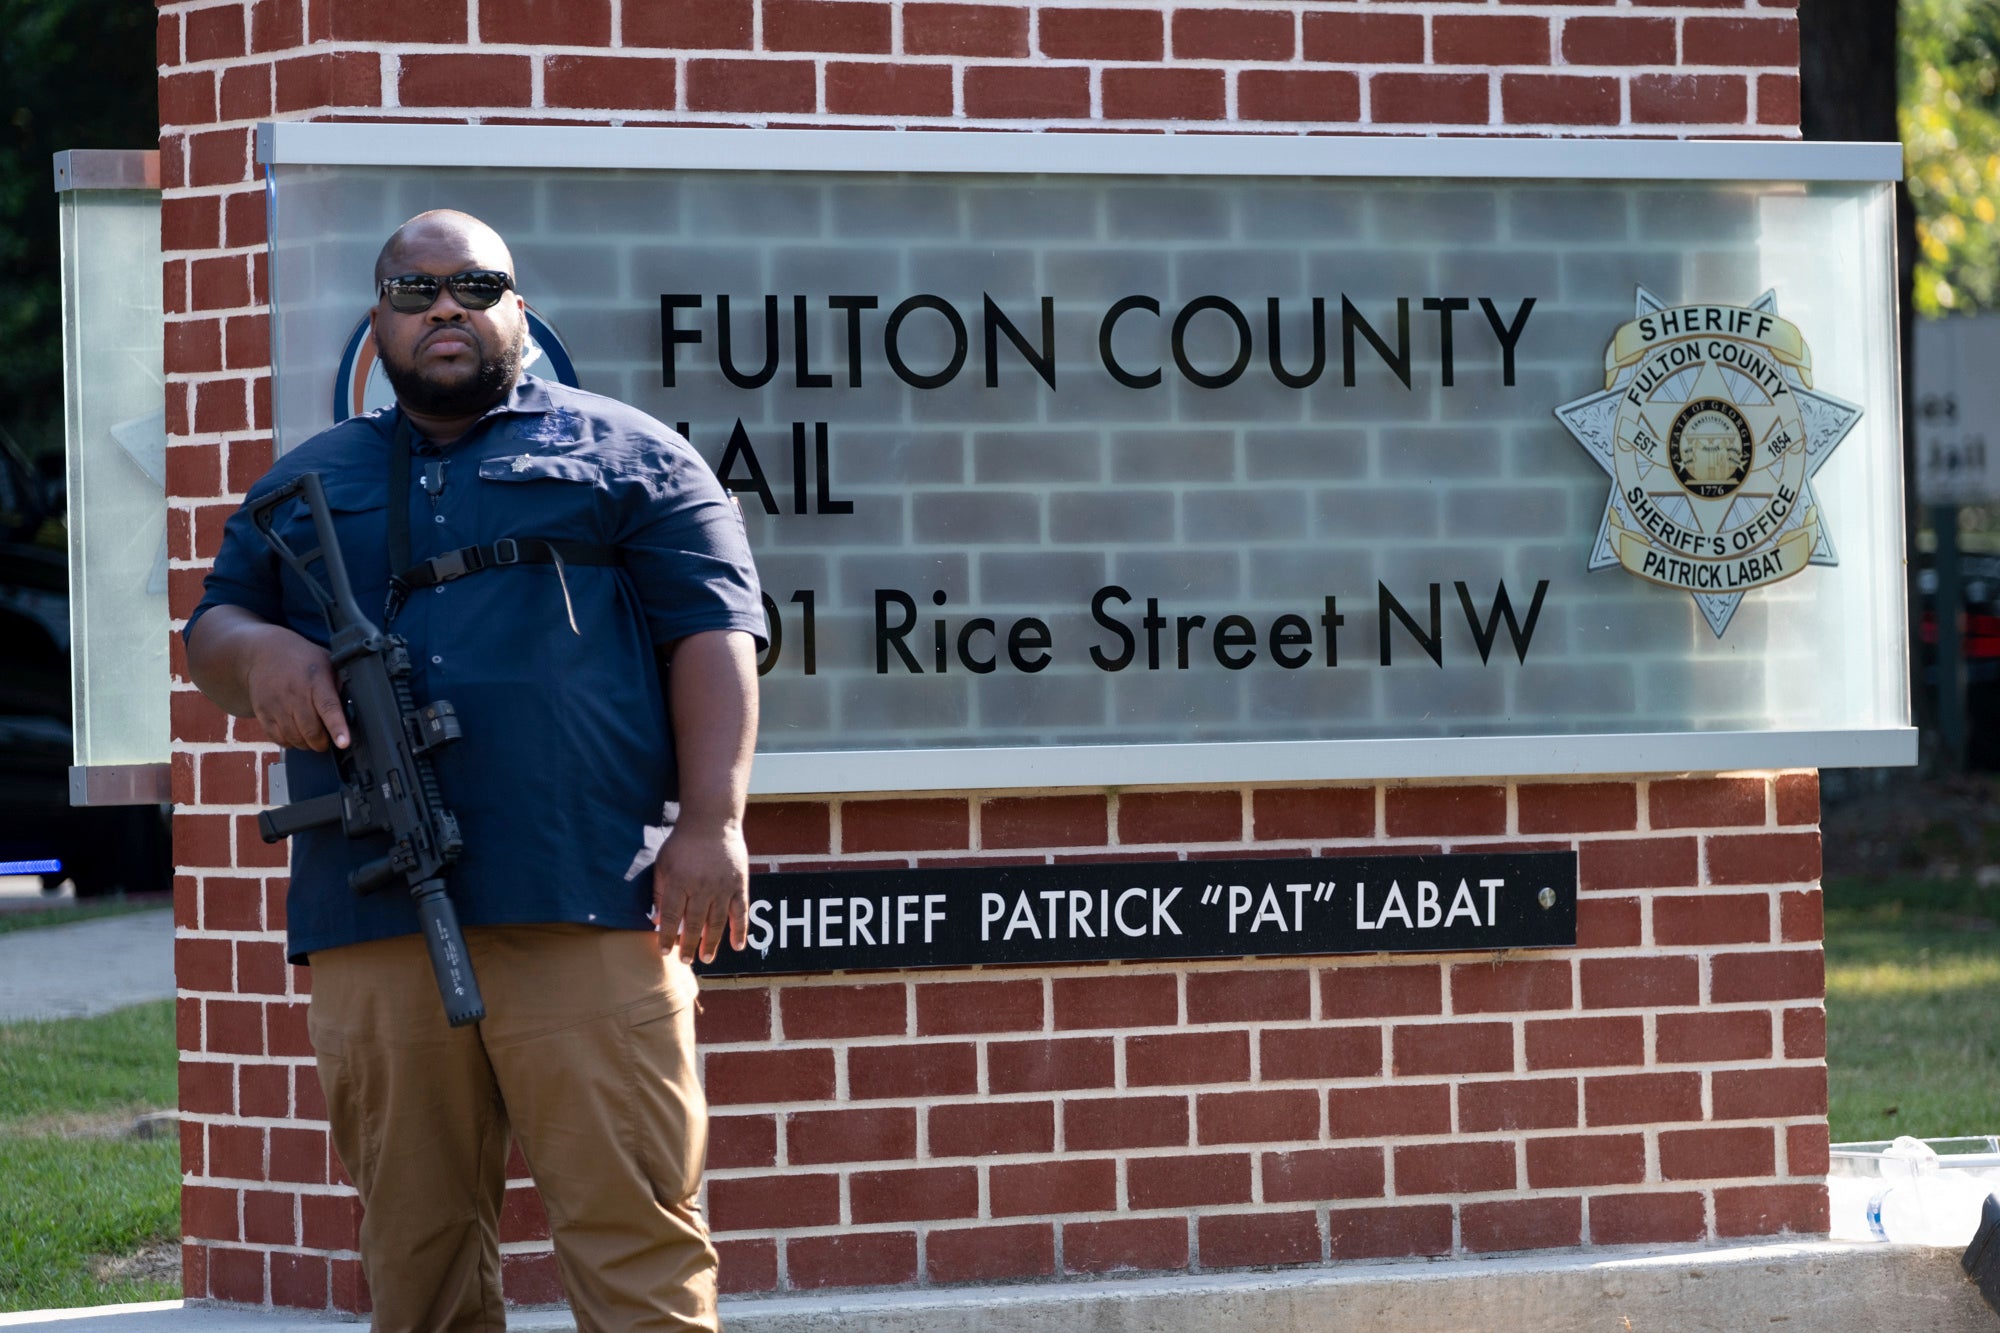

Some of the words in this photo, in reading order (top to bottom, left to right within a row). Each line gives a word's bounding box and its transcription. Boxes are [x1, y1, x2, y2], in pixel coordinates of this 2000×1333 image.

[660, 291, 1056, 392] FULTON
[1099, 292, 1537, 392] COUNTY
[1639, 308, 1774, 342] SHERIFF
[1627, 342, 1701, 407] FULTON
[1708, 341, 1788, 399] COUNTY
[1633, 430, 1658, 458] EST.
[1672, 412, 1690, 460] STATE
[1692, 402, 1706, 413] OF
[1711, 401, 1751, 459] GEORGIA
[1767, 430, 1792, 458] 1854
[677, 417, 854, 514] AIL
[1700, 485, 1725, 496] 1776
[1628, 486, 1726, 555] SHERIFF'S
[1732, 484, 1796, 550] OFFICE
[1643, 551, 1722, 588] PATRICK
[1727, 549, 1784, 587] LABAT
[874, 588, 1053, 674] Rice
[1089, 585, 1345, 673] Street
[1378, 579, 1550, 670] NW
[747, 894, 947, 950] SHERIFF
[981, 887, 1183, 942] PATRICK
[1356, 878, 1505, 931] LABAT
